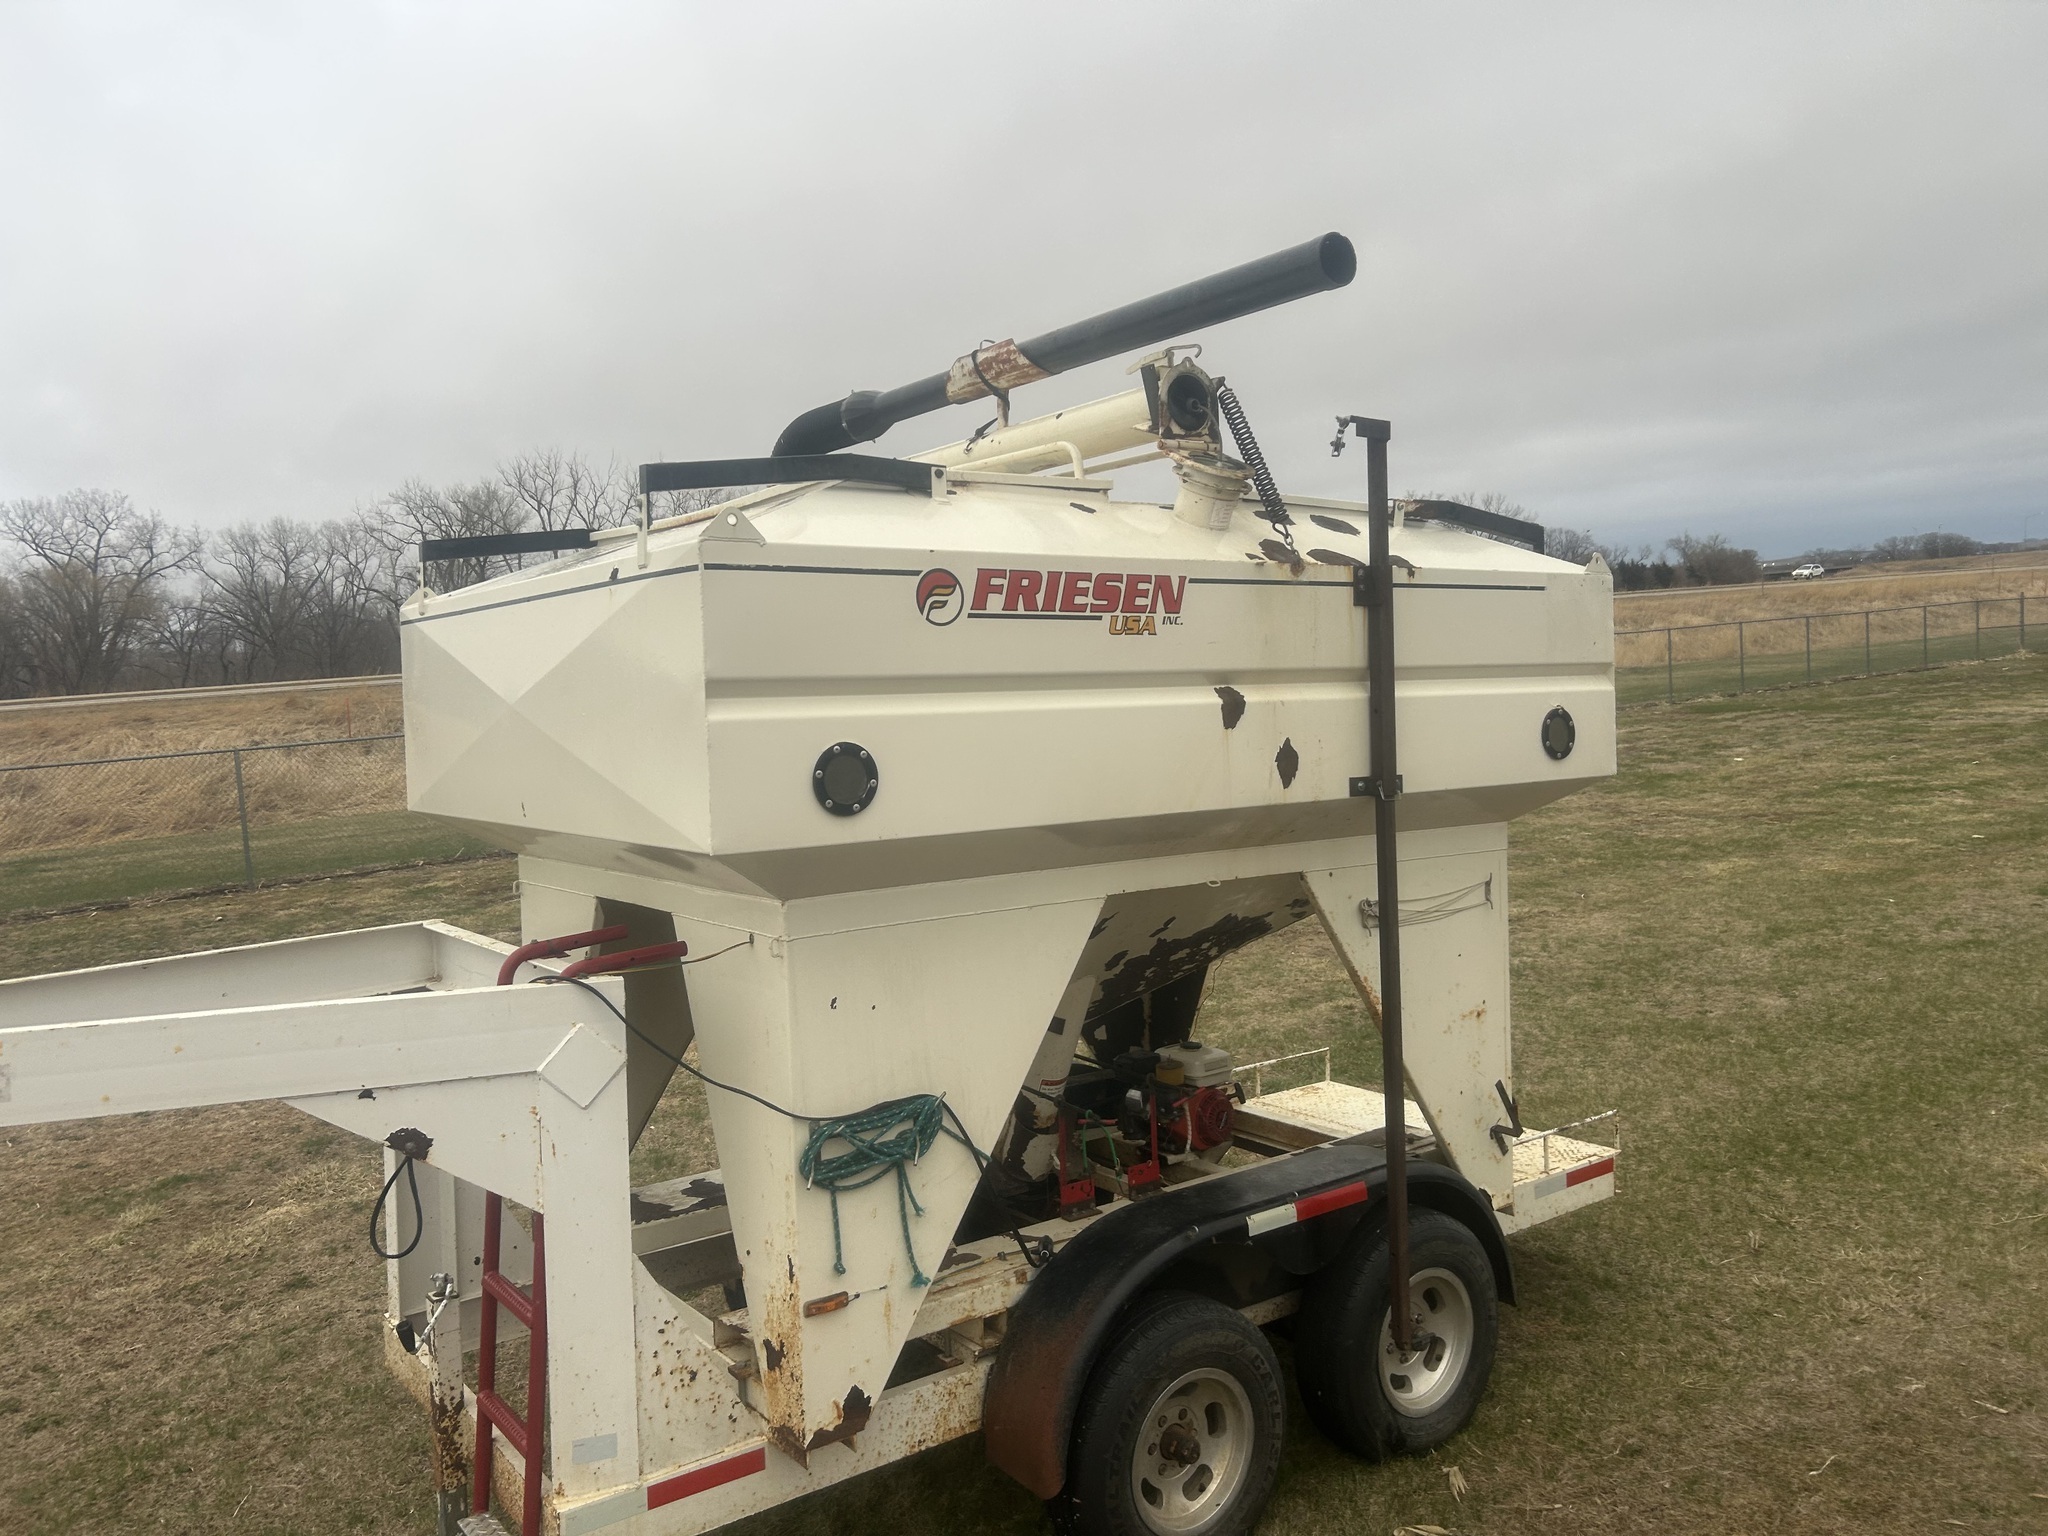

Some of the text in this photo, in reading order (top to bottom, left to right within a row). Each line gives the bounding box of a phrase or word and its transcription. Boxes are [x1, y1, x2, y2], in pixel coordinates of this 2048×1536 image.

[970, 567, 1187, 614] FRIESEN
[1108, 615, 1183, 636] USA INC.
